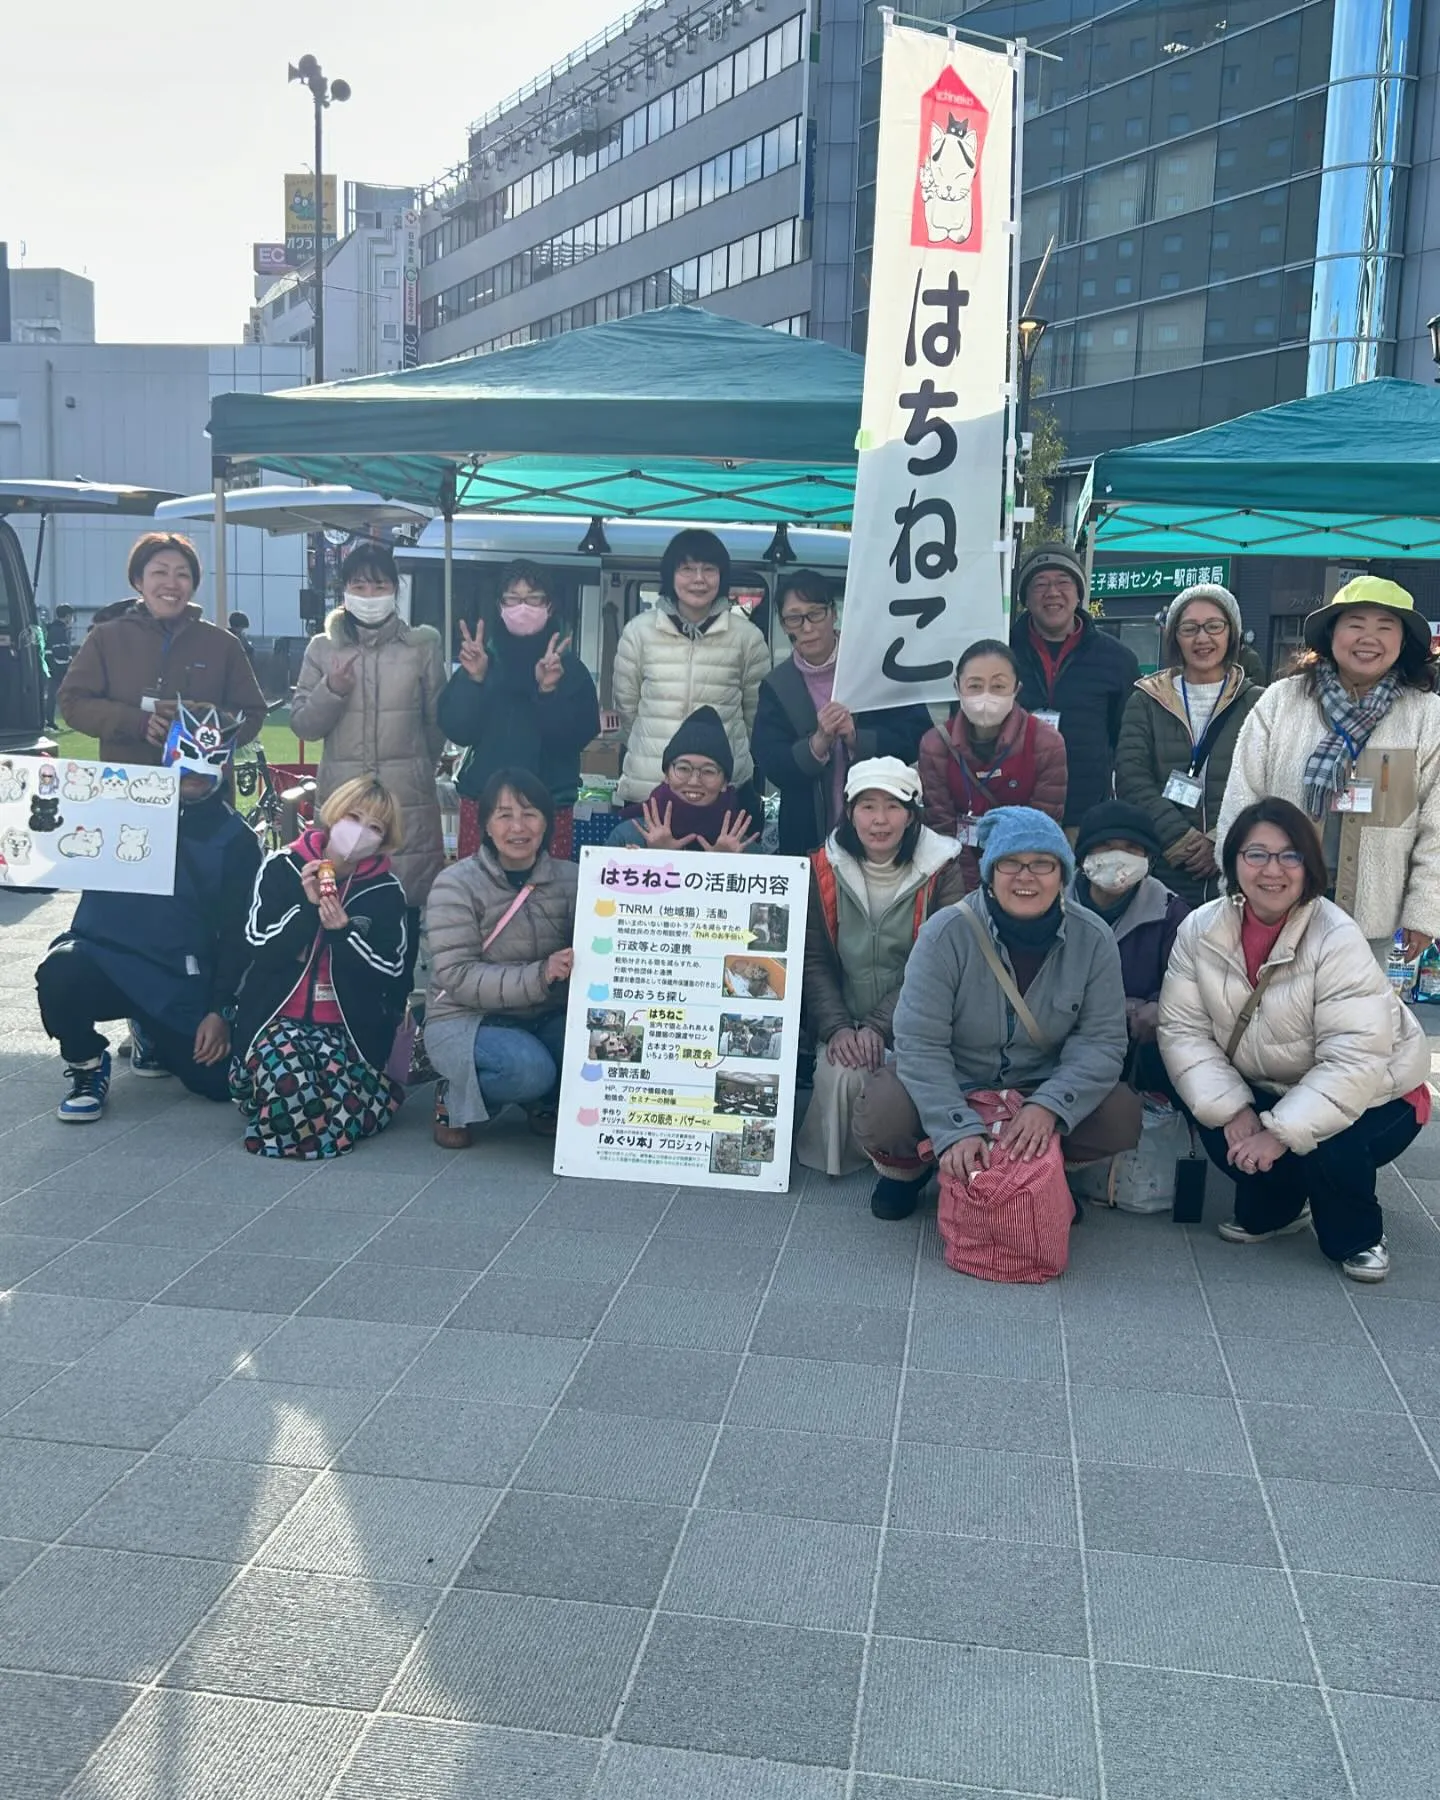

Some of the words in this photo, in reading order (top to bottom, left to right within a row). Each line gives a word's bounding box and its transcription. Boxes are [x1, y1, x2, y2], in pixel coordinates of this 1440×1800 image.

[881, 267, 970, 683] はちねこ
[600, 866, 790, 896] はちねこの活動内容
[617, 940, 692, 955] 行政等との連携
[613, 988, 687, 1003] 猫のおうち探し
[649, 1008, 683, 1021] はちねこ
